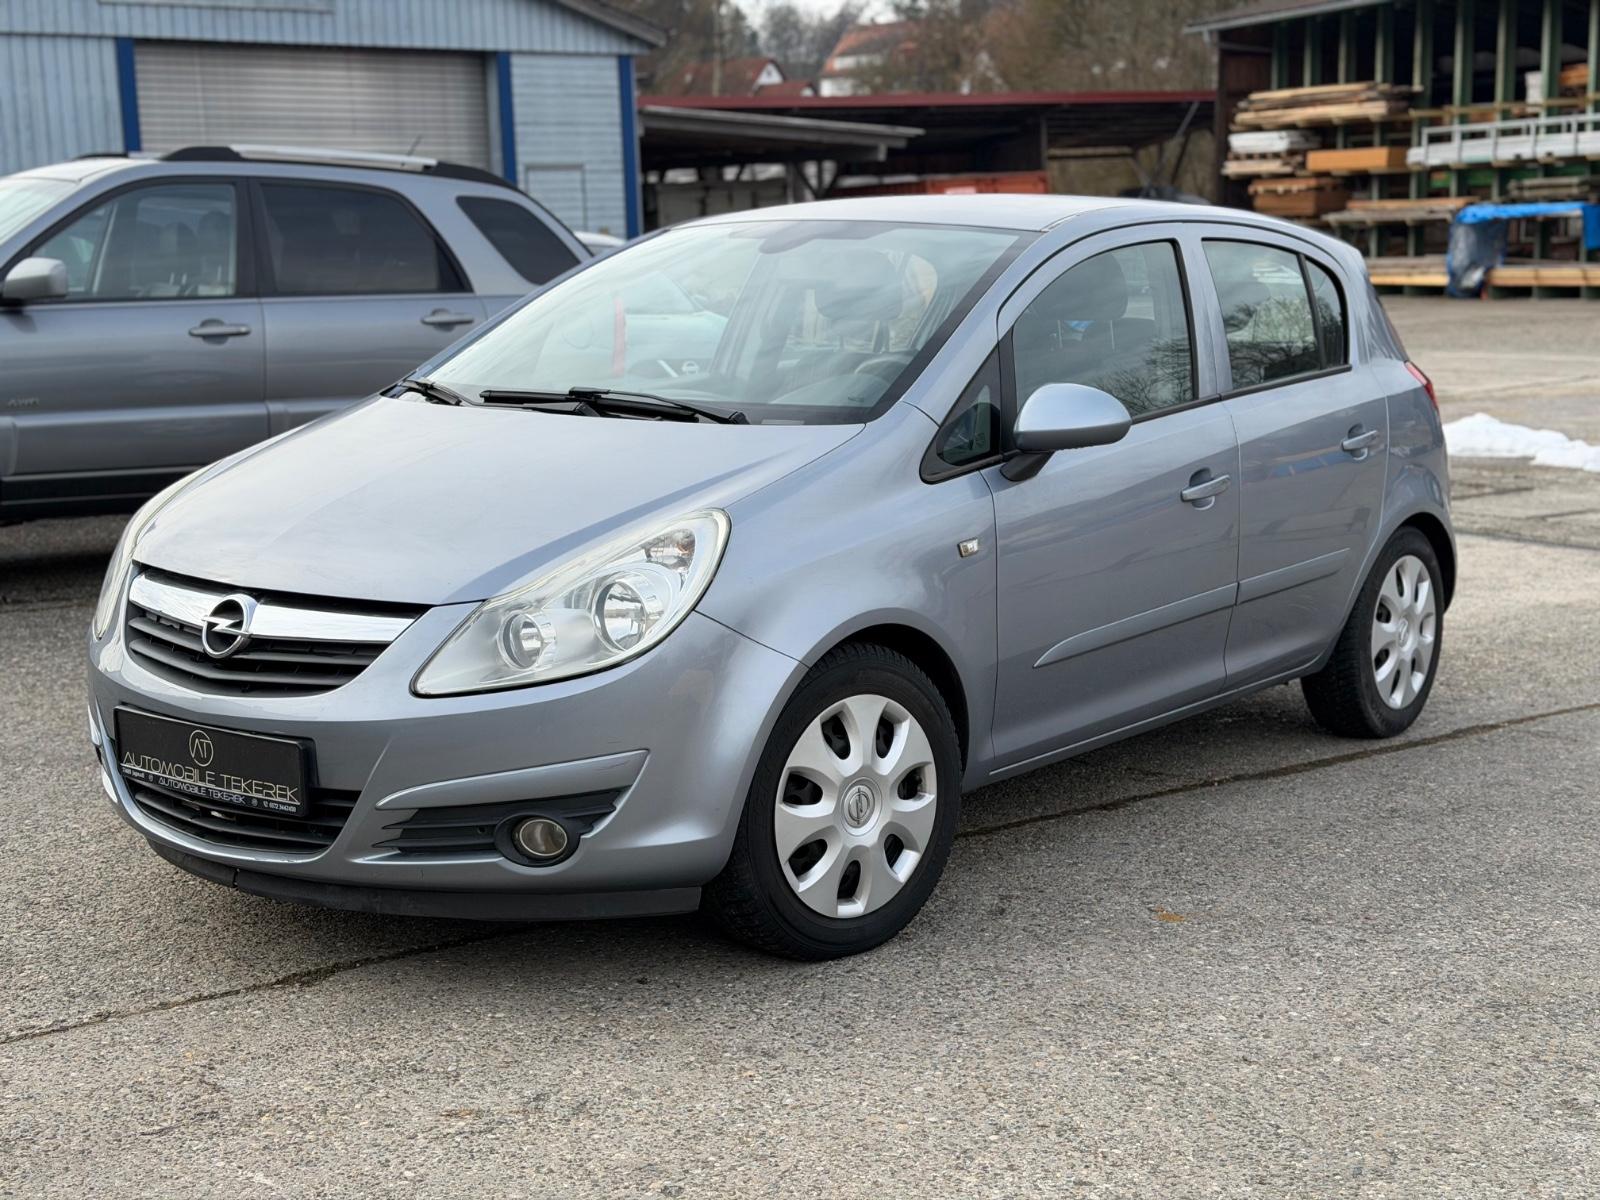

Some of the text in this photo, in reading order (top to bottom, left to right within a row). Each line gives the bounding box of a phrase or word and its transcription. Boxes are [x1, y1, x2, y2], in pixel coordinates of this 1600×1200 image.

[123, 751, 299, 803] AUTOMOBILE TEKEREK
[158, 777, 246, 805] AUTOMOBILE TEKEREK
